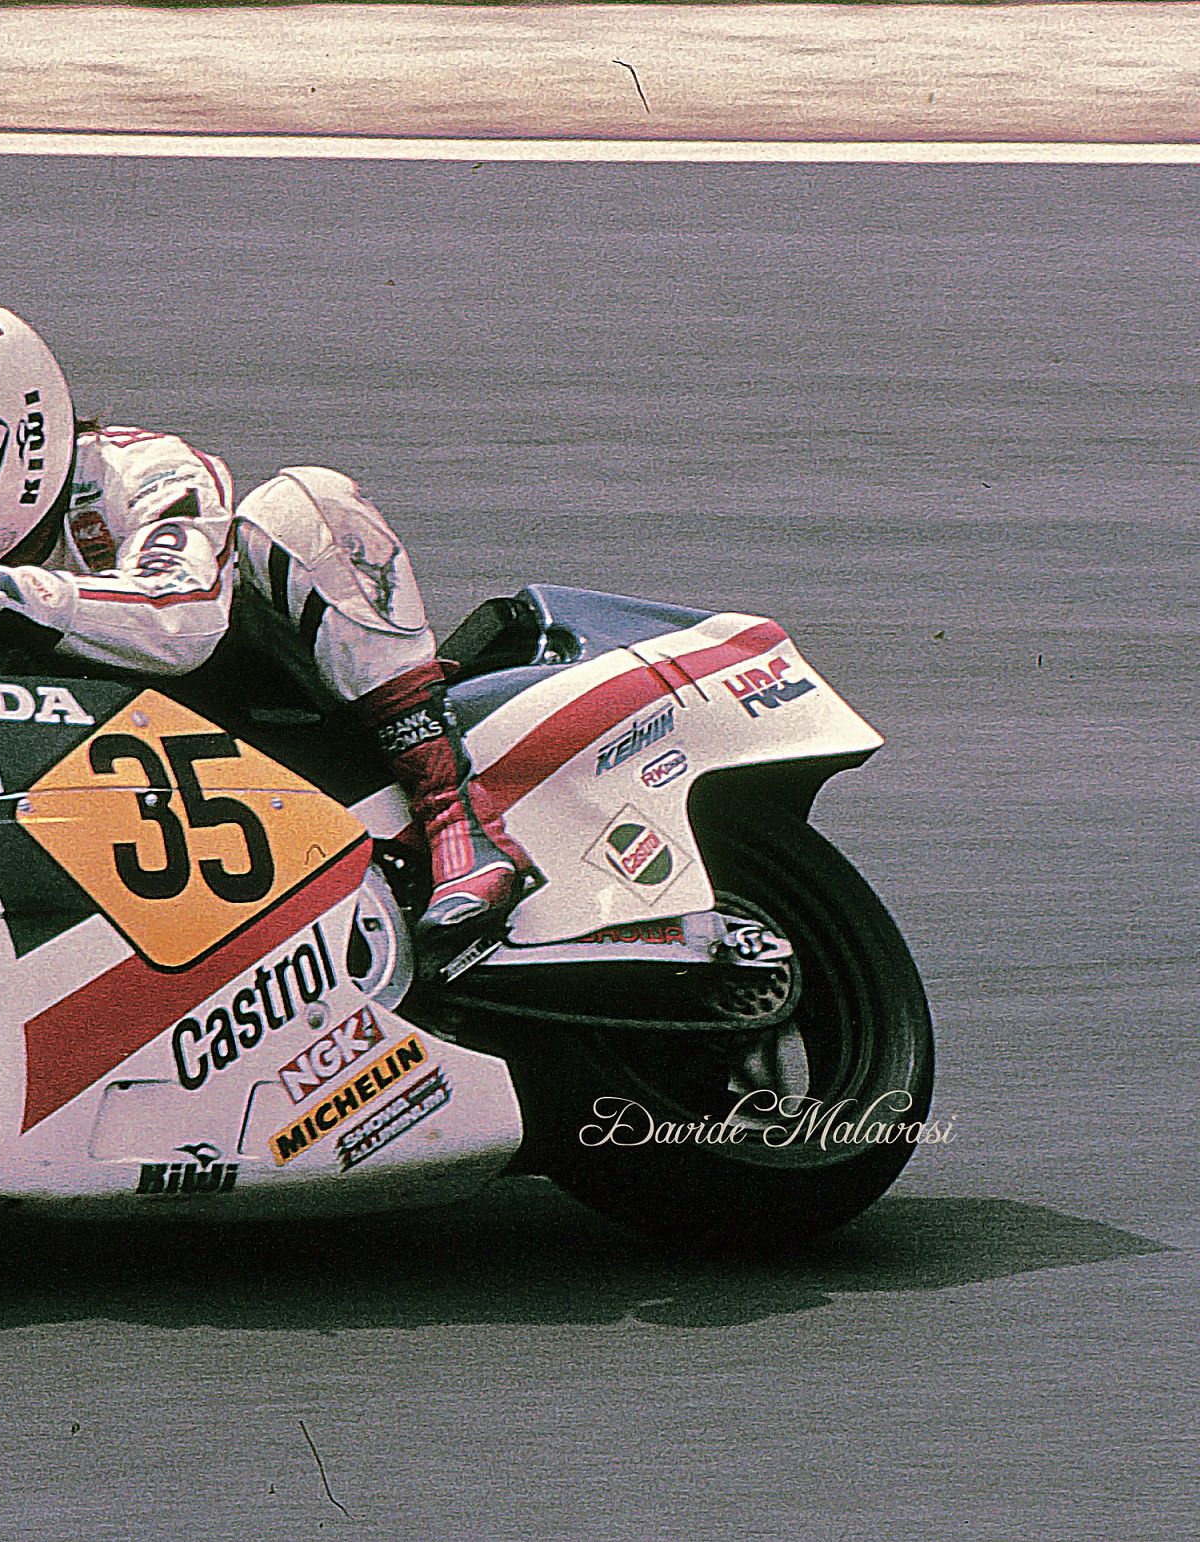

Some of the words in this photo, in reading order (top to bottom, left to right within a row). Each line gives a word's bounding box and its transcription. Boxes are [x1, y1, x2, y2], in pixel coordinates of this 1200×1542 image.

[88, 732, 276, 904] 35
[172, 921, 340, 1091] Castrol
[281, 1015, 370, 1102] NGK
[276, 1038, 424, 1159] MICHELIN
